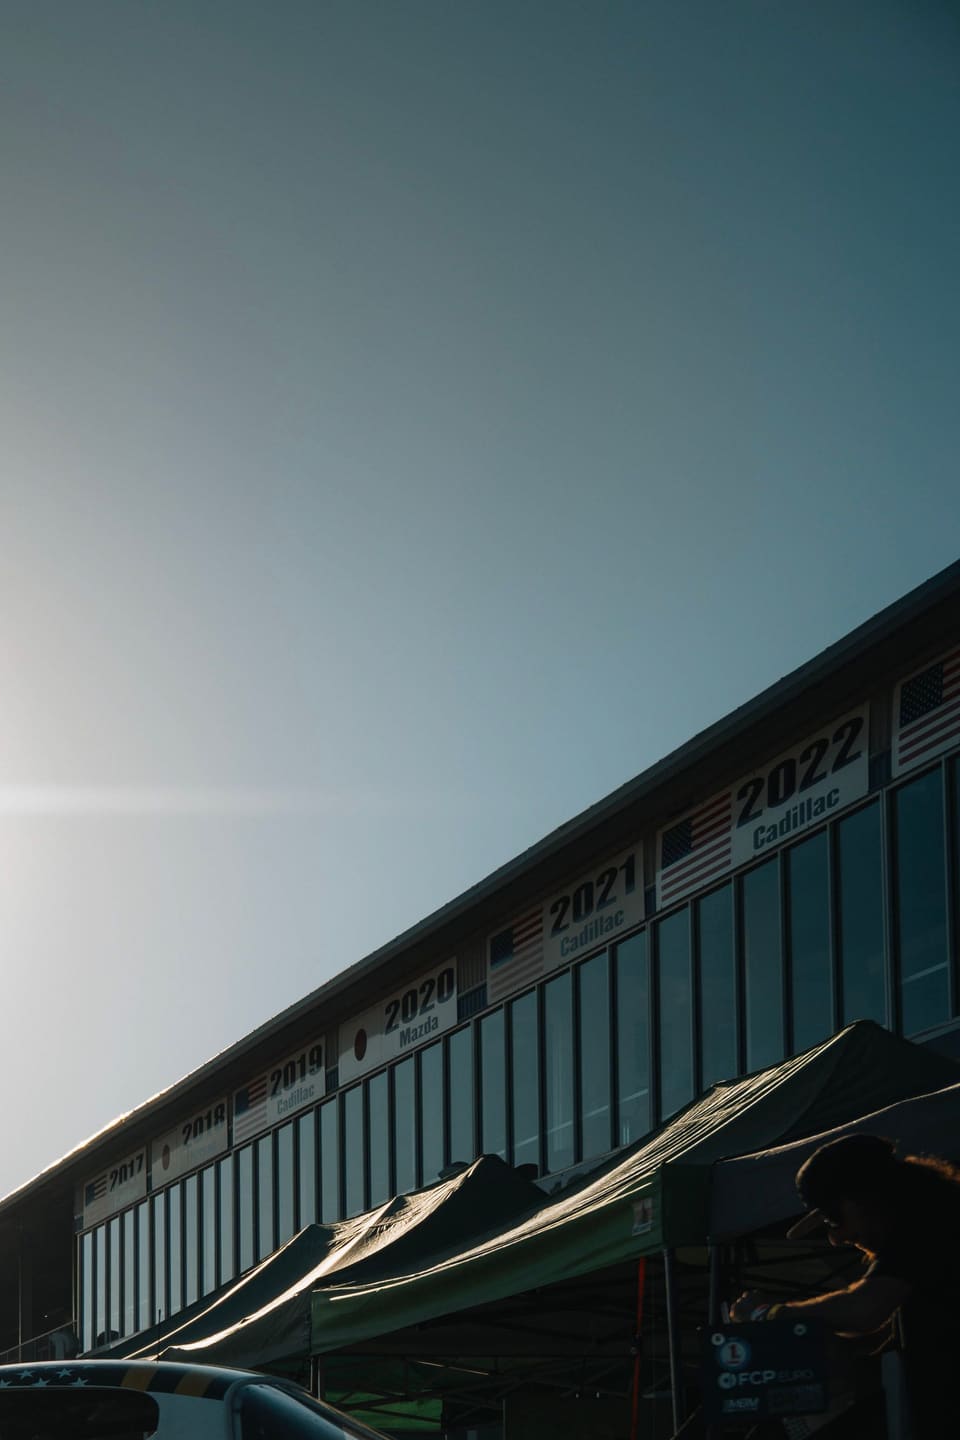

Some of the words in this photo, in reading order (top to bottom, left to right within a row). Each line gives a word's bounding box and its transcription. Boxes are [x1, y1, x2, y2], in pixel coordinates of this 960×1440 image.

[736, 716, 865, 829] 2022
[753, 787, 840, 851] Cadillac
[550, 853, 635, 937] 2021
[560, 908, 625, 957] Cadillac
[384, 966, 455, 1034] 2020
[399, 1013, 439, 1049] Mazda
[270, 1045, 322, 1100] 2019
[182, 1102, 226, 1145] 2018
[276, 1084, 315, 1115] Cadillac
[109, 1152, 145, 1192] 2017
[738, 1369, 777, 1386] FCP
